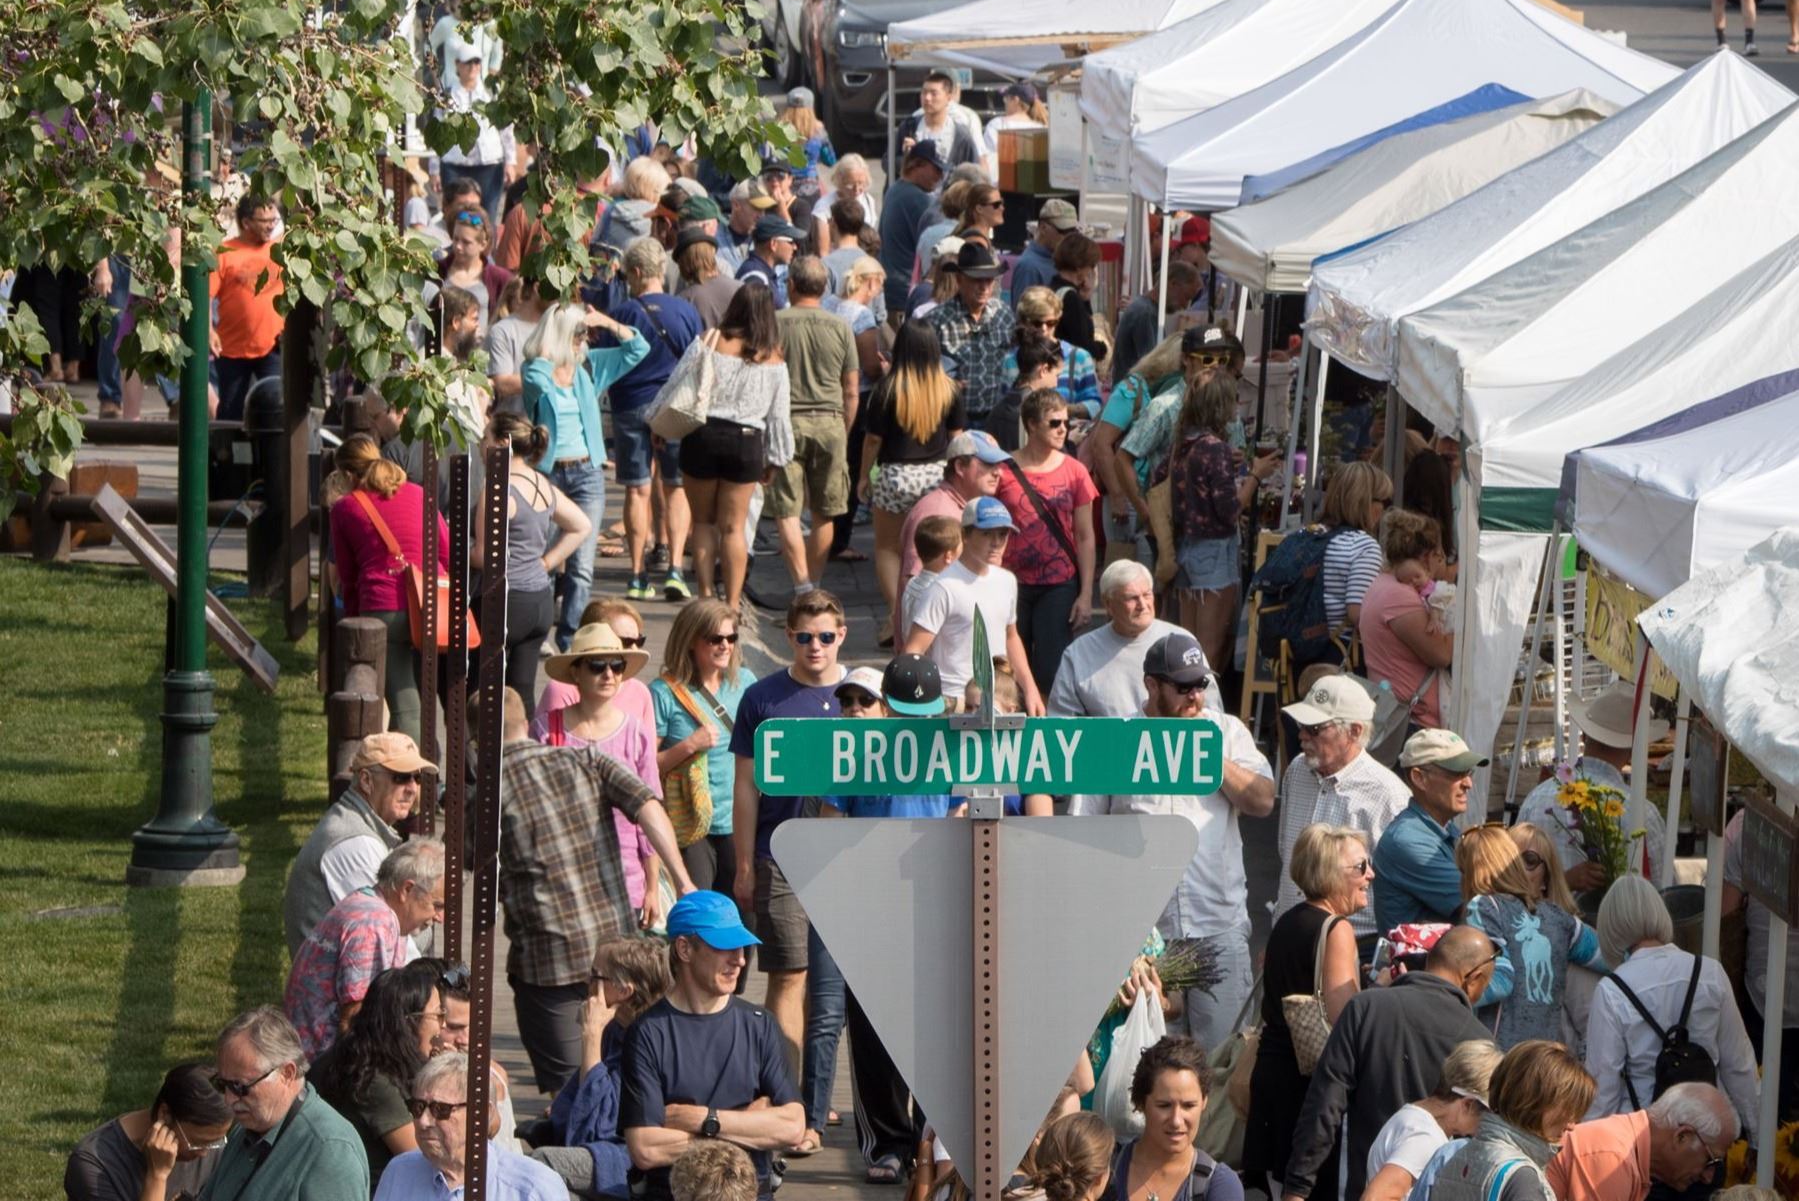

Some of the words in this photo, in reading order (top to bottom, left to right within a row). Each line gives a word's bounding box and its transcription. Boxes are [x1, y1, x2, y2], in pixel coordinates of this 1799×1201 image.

[763, 730, 784, 783] E
[832, 729, 1083, 784] BROADWAY
[1131, 730, 1214, 784] AVE
